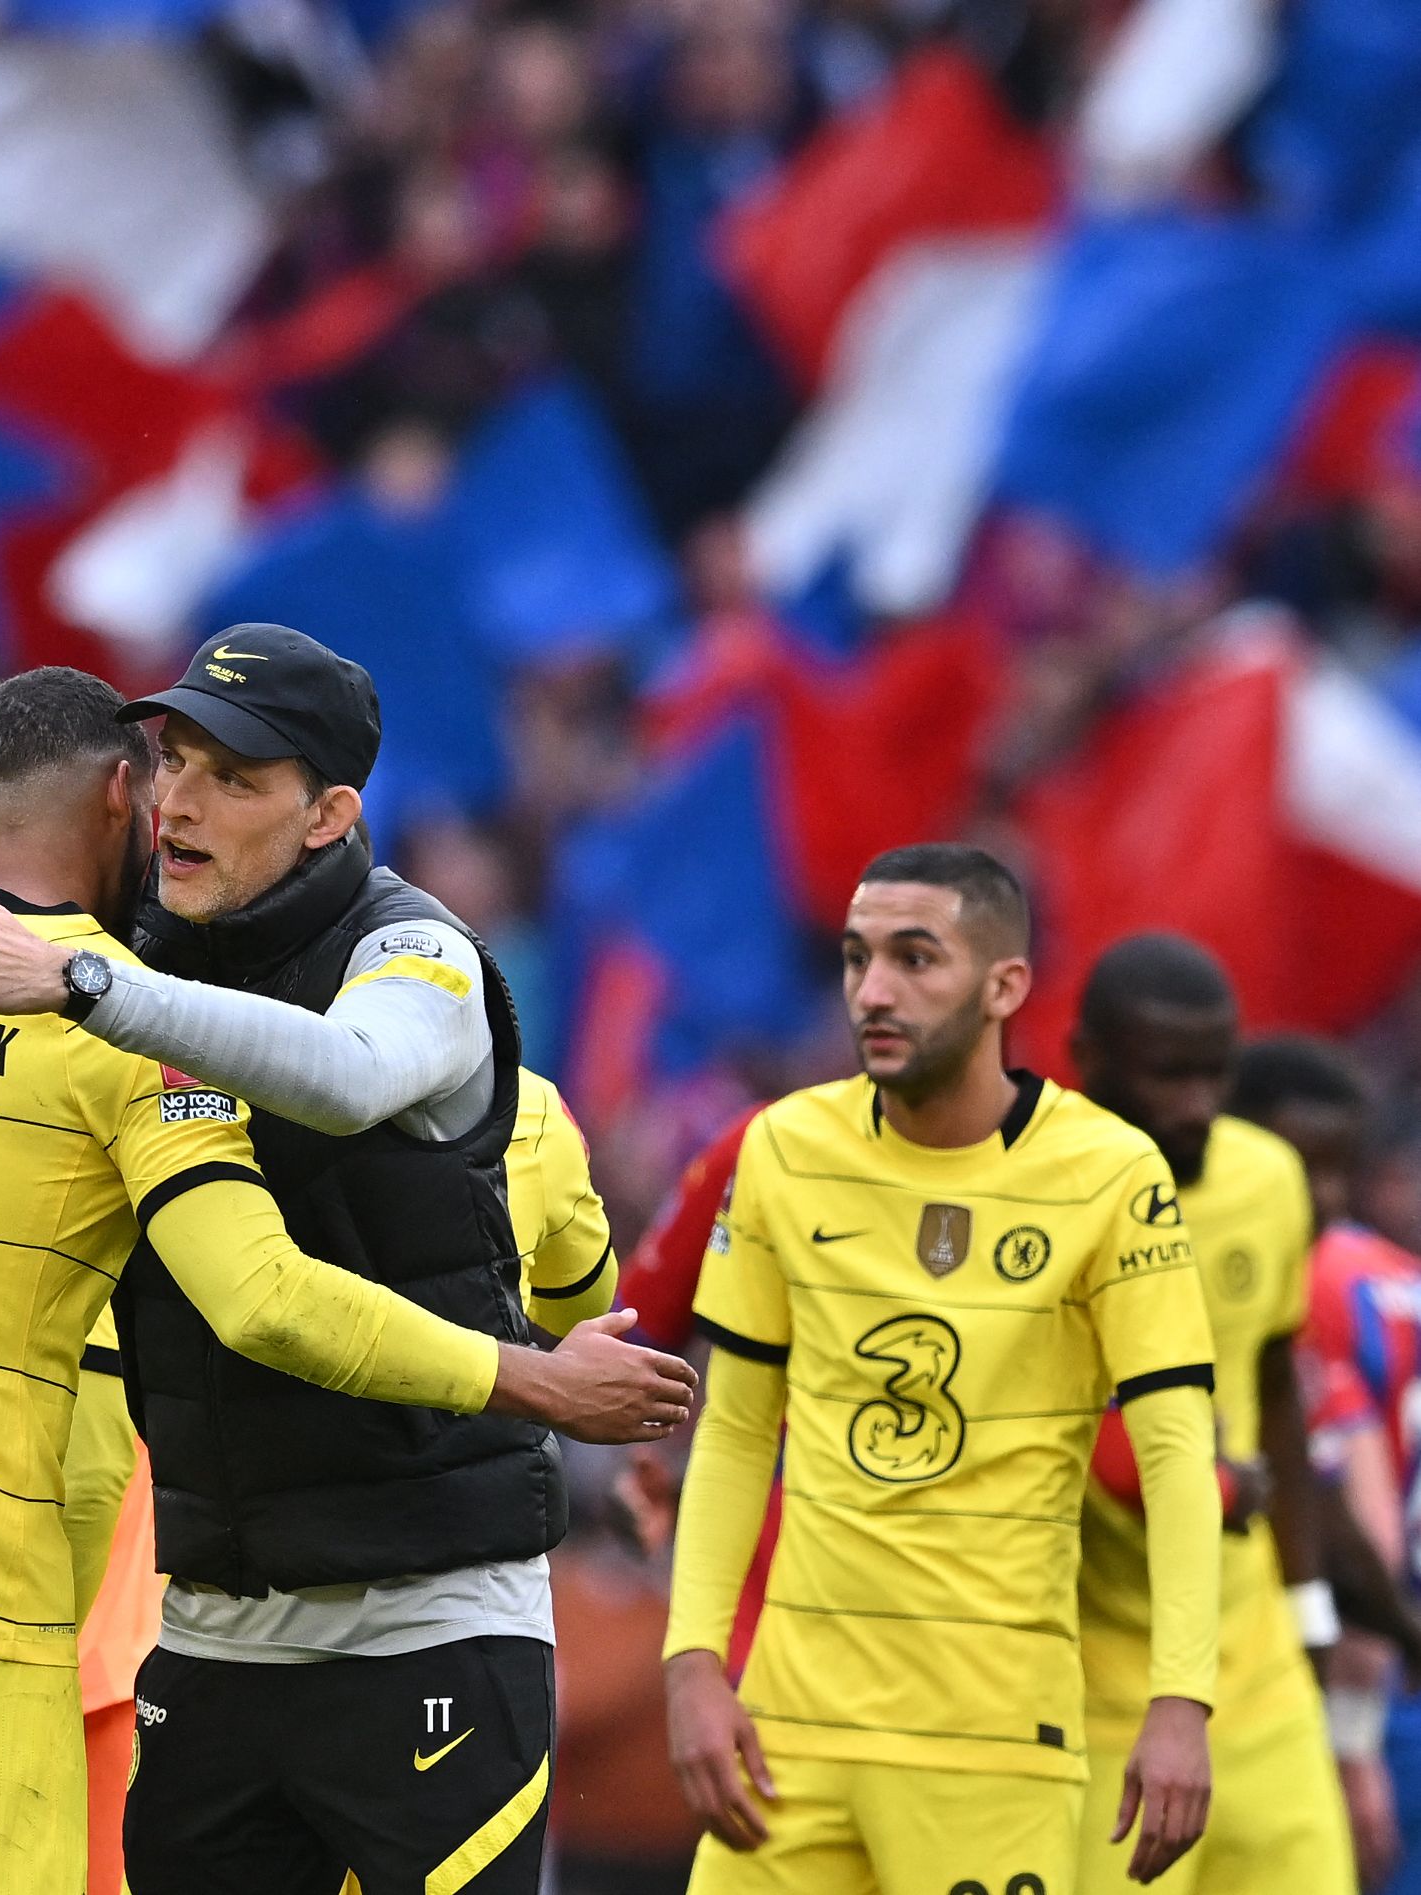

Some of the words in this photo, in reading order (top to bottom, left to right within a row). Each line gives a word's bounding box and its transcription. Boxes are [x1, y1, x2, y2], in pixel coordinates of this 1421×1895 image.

[233, 672, 247, 684] FC
[159, 1093, 187, 1109] No
[189, 1093, 231, 1112] room
[423, 1697, 453, 1733] TT
